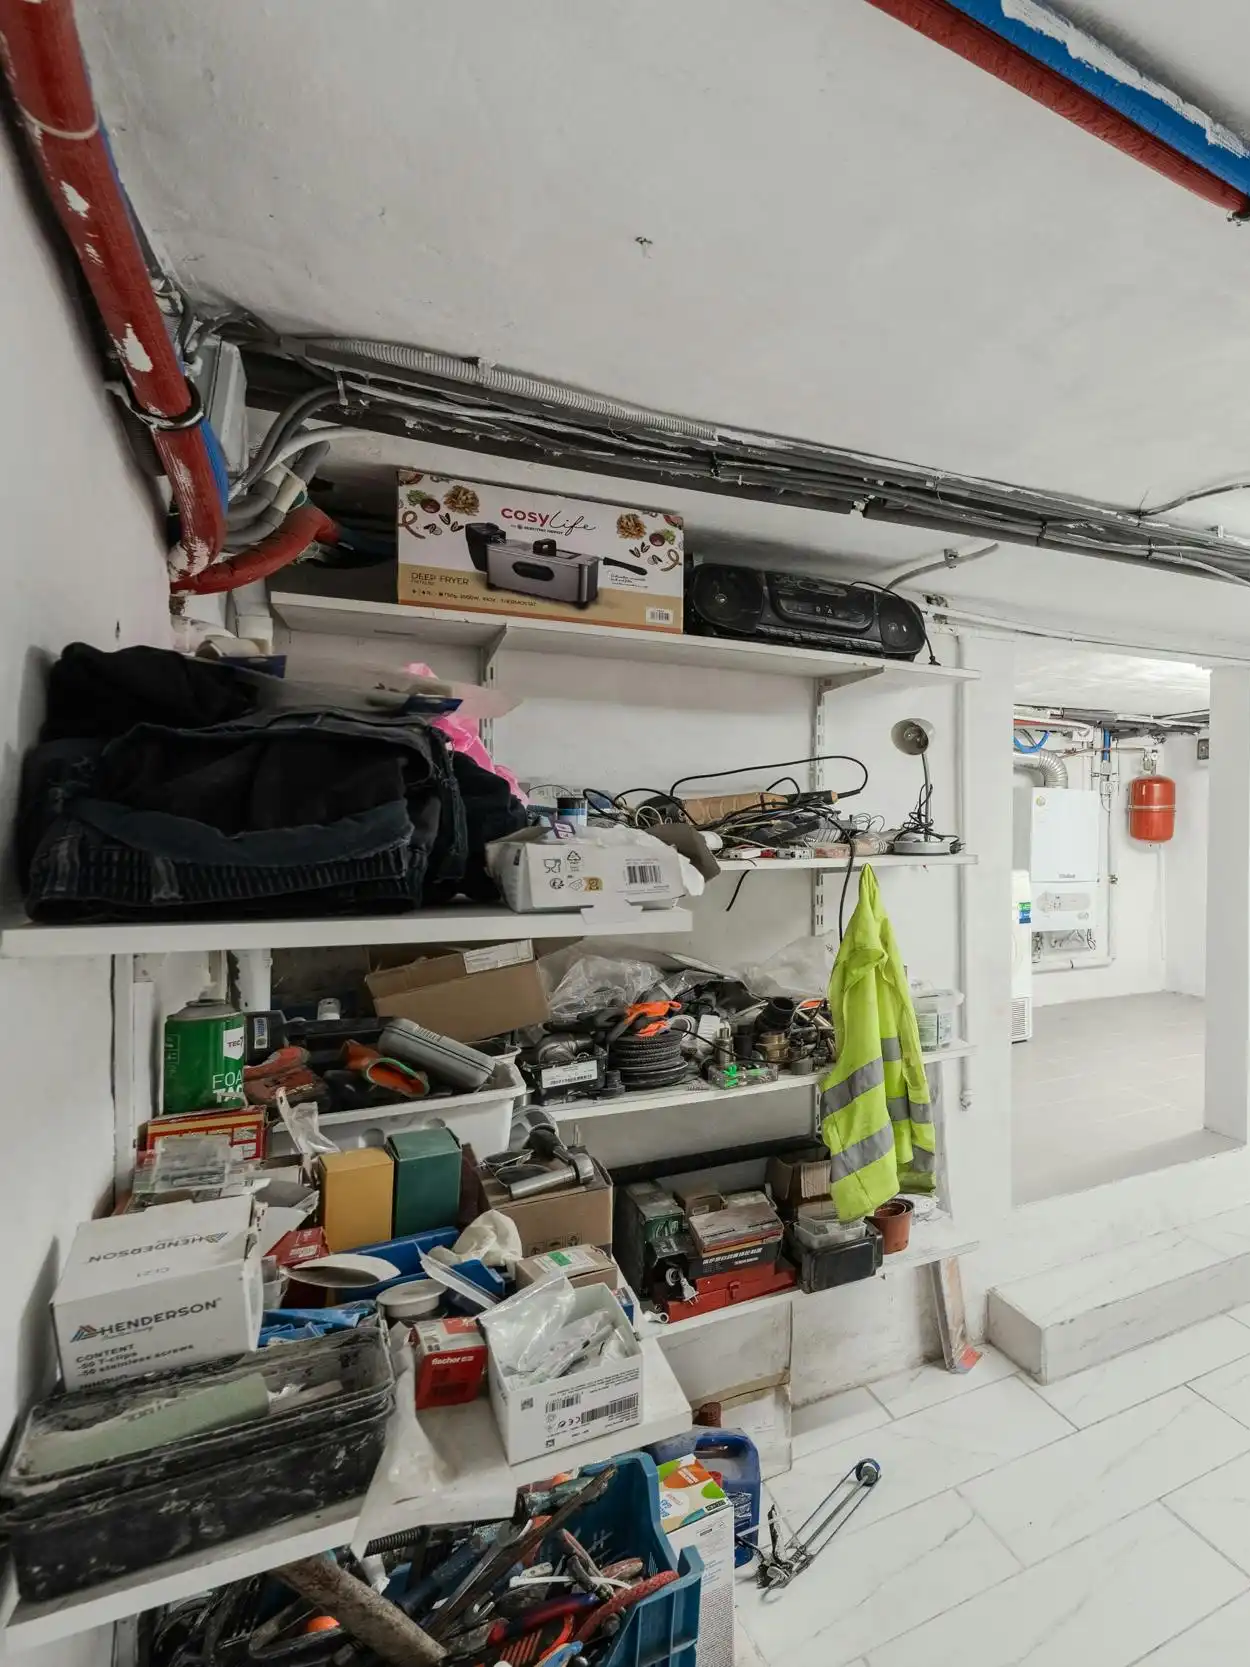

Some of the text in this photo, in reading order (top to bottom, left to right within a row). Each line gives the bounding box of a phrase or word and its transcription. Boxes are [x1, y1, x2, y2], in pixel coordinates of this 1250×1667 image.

[411, 572, 436, 581] DEEP
[440, 575, 469, 585] FRYER
[212, 1070, 243, 1089] FOA
[100, 1300, 218, 1336] HENDERSON
[76, 1344, 134, 1363] CONTENT
[100, 1355, 151, 1373] stainless
[154, 1344, 194, 1358] screws
